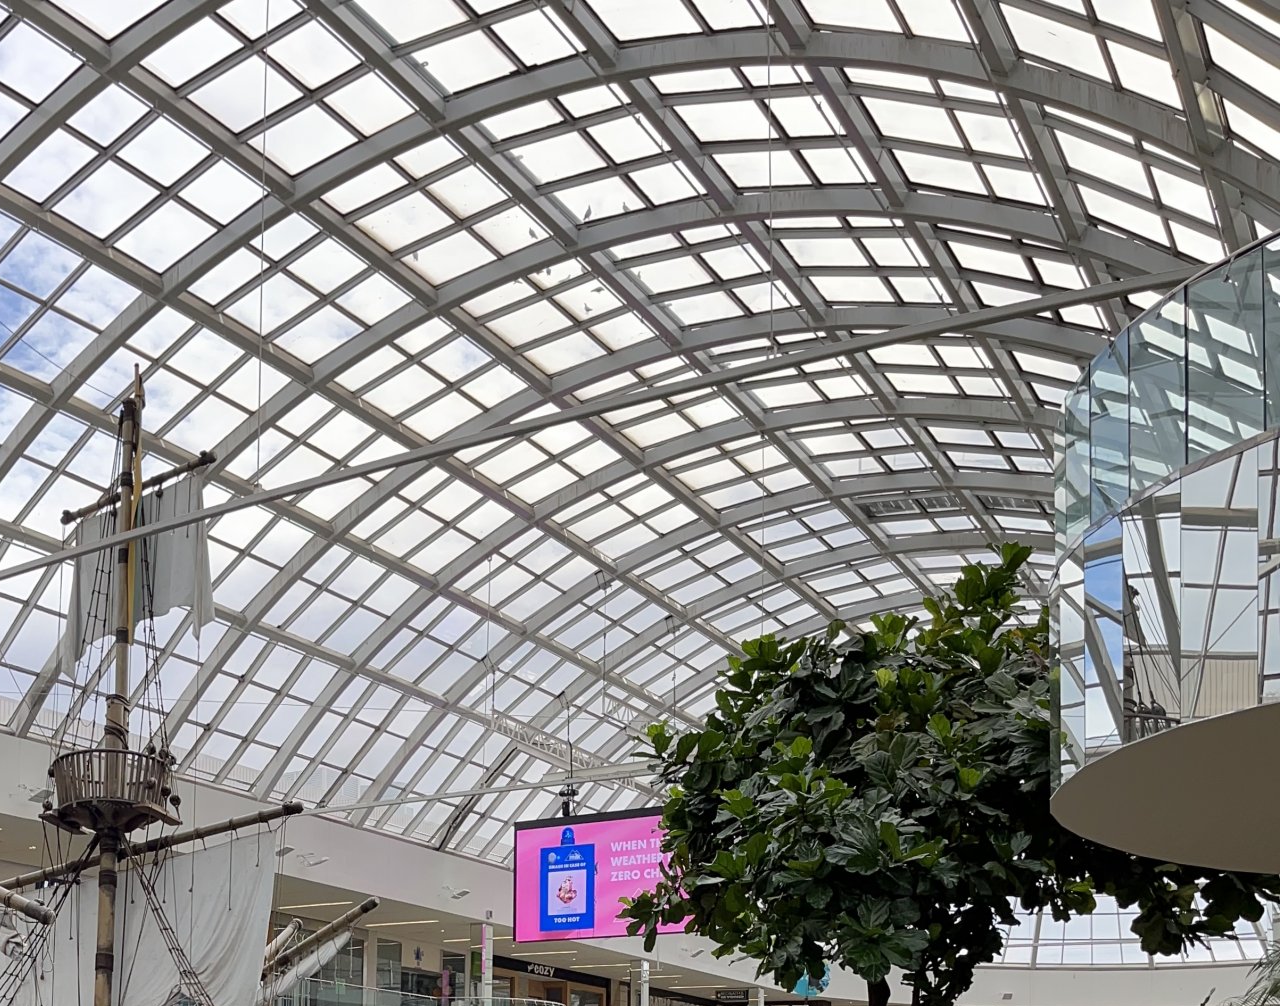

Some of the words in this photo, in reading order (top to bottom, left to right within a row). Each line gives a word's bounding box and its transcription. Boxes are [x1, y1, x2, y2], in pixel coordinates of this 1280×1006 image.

[610, 839, 647, 852] WHEN
[610, 854, 662, 867] WEATHER
[610, 870, 641, 882] ZERO
